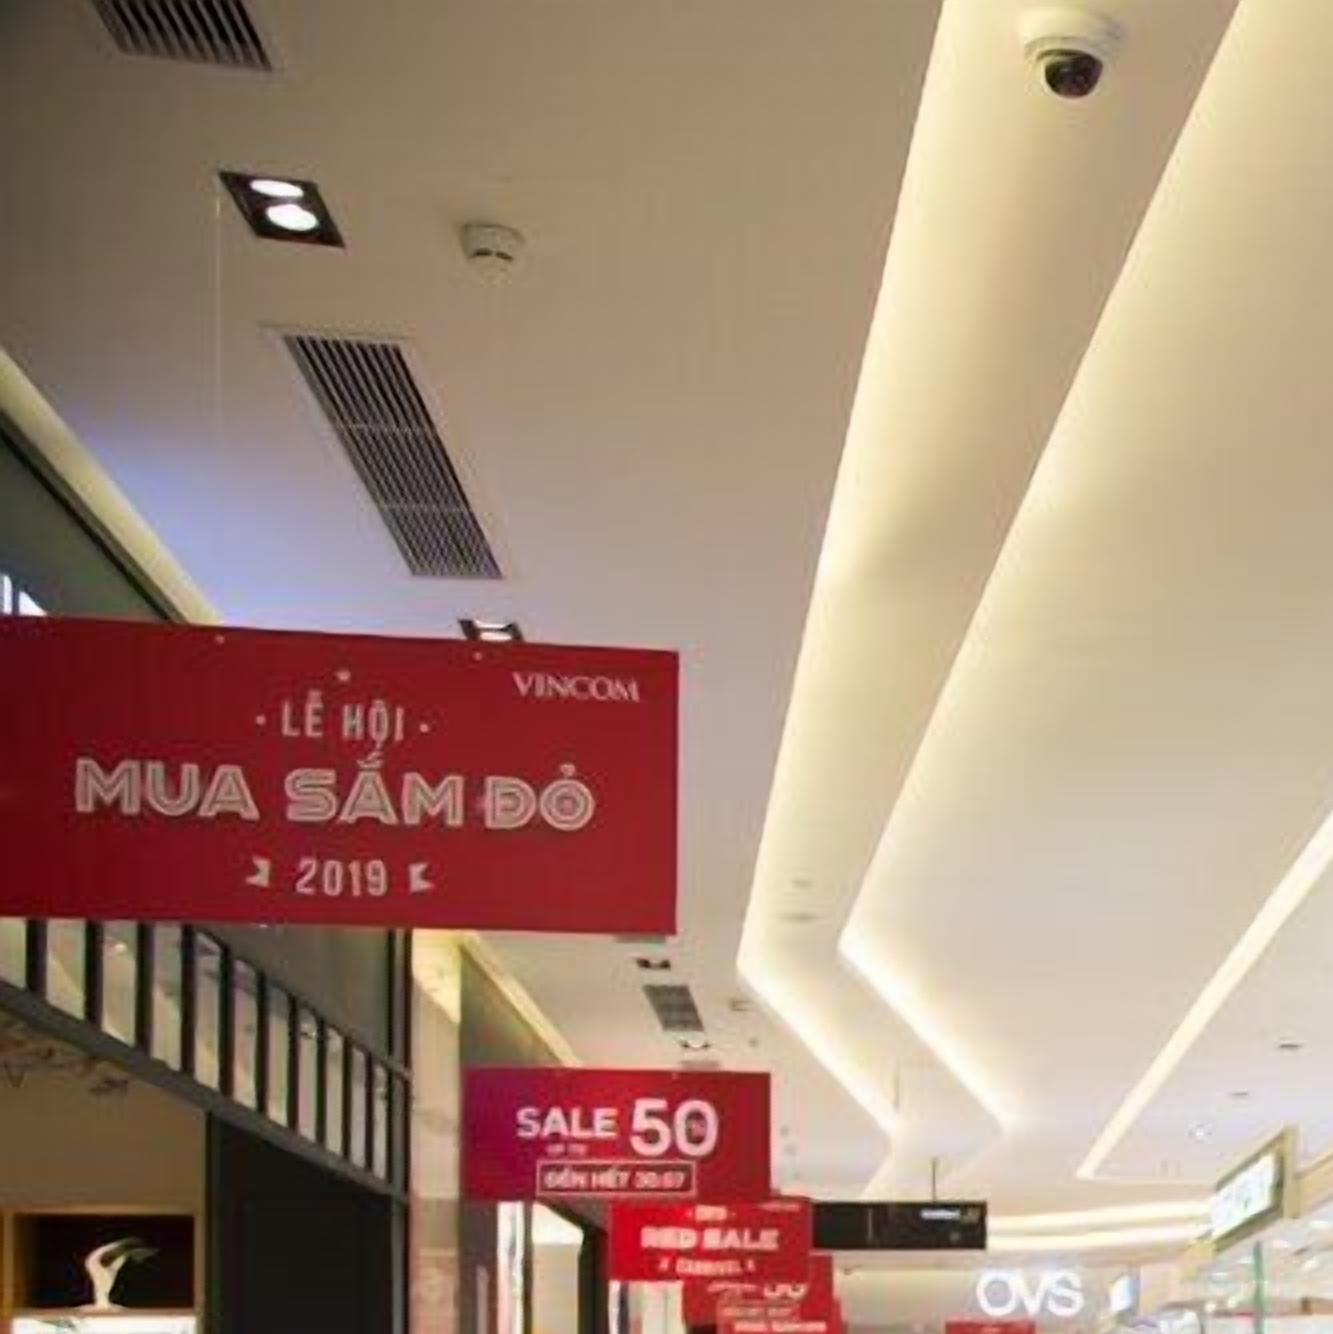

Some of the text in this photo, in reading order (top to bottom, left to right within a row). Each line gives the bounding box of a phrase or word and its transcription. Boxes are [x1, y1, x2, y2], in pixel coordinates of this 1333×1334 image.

[512, 671, 640, 702] VINCOM
[75, 750, 596, 831] MUA SẮM ĐỎ
[295, 856, 389, 897] 2019
[515, 1097, 720, 1158] SALE 50
[976, 1269, 1085, 1317] OVS
